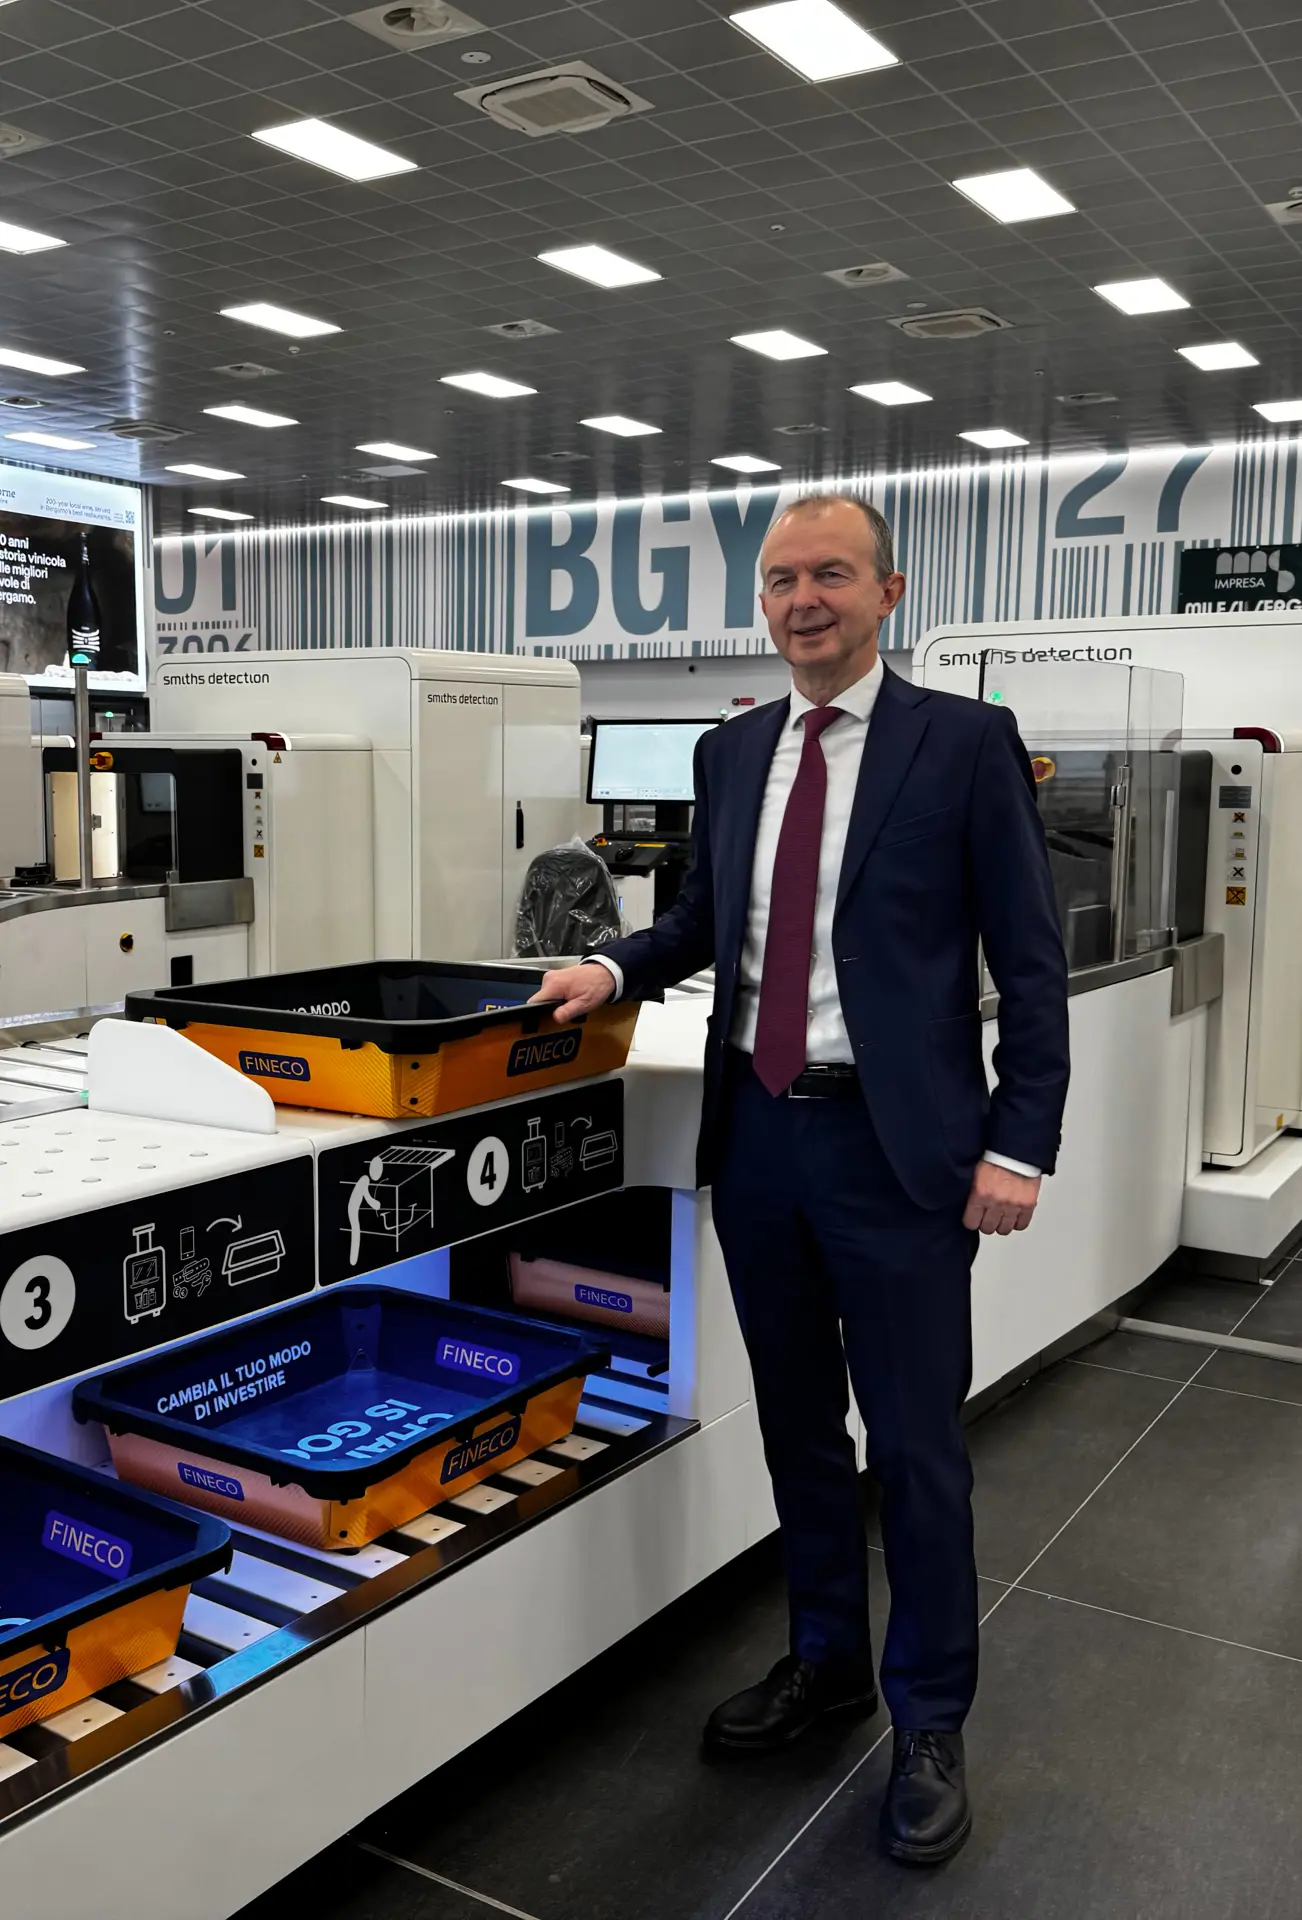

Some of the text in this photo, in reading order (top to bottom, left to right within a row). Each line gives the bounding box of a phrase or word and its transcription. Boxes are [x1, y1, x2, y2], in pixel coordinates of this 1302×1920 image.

[8, 537, 29, 549] anni
[28, 552, 66, 568] vinicola
[525, 485, 781, 638] BGY
[12, 564, 48, 579] migliori
[20, 578, 30, 590] di
[1214, 577, 1265, 589] IMPRESA
[0, 591, 36, 605] rgamo.
[939, 646, 1132, 666] smiths detection
[163, 672, 270, 685] smiths detection
[427, 693, 498, 705] smiths detection
[310, 1000, 351, 1016] MODO
[514, 1036, 576, 1069] FINECO
[245, 1056, 304, 1076] FINECO
[480, 1151, 497, 1191] 4
[24, 1275, 52, 1331] 3
[579, 1289, 629, 1309] FINECO
[443, 1345, 513, 1376] FINECO
[157, 1341, 312, 1414] CAMBIA IL TUO MODO
[194, 1371, 286, 1421] DI INVESTIRE
[365, 1398, 421, 1421] IS
[447, 1426, 514, 1476] FINECO
[183, 1468, 238, 1496] FINECO
[50, 1519, 124, 1569] FINECO
